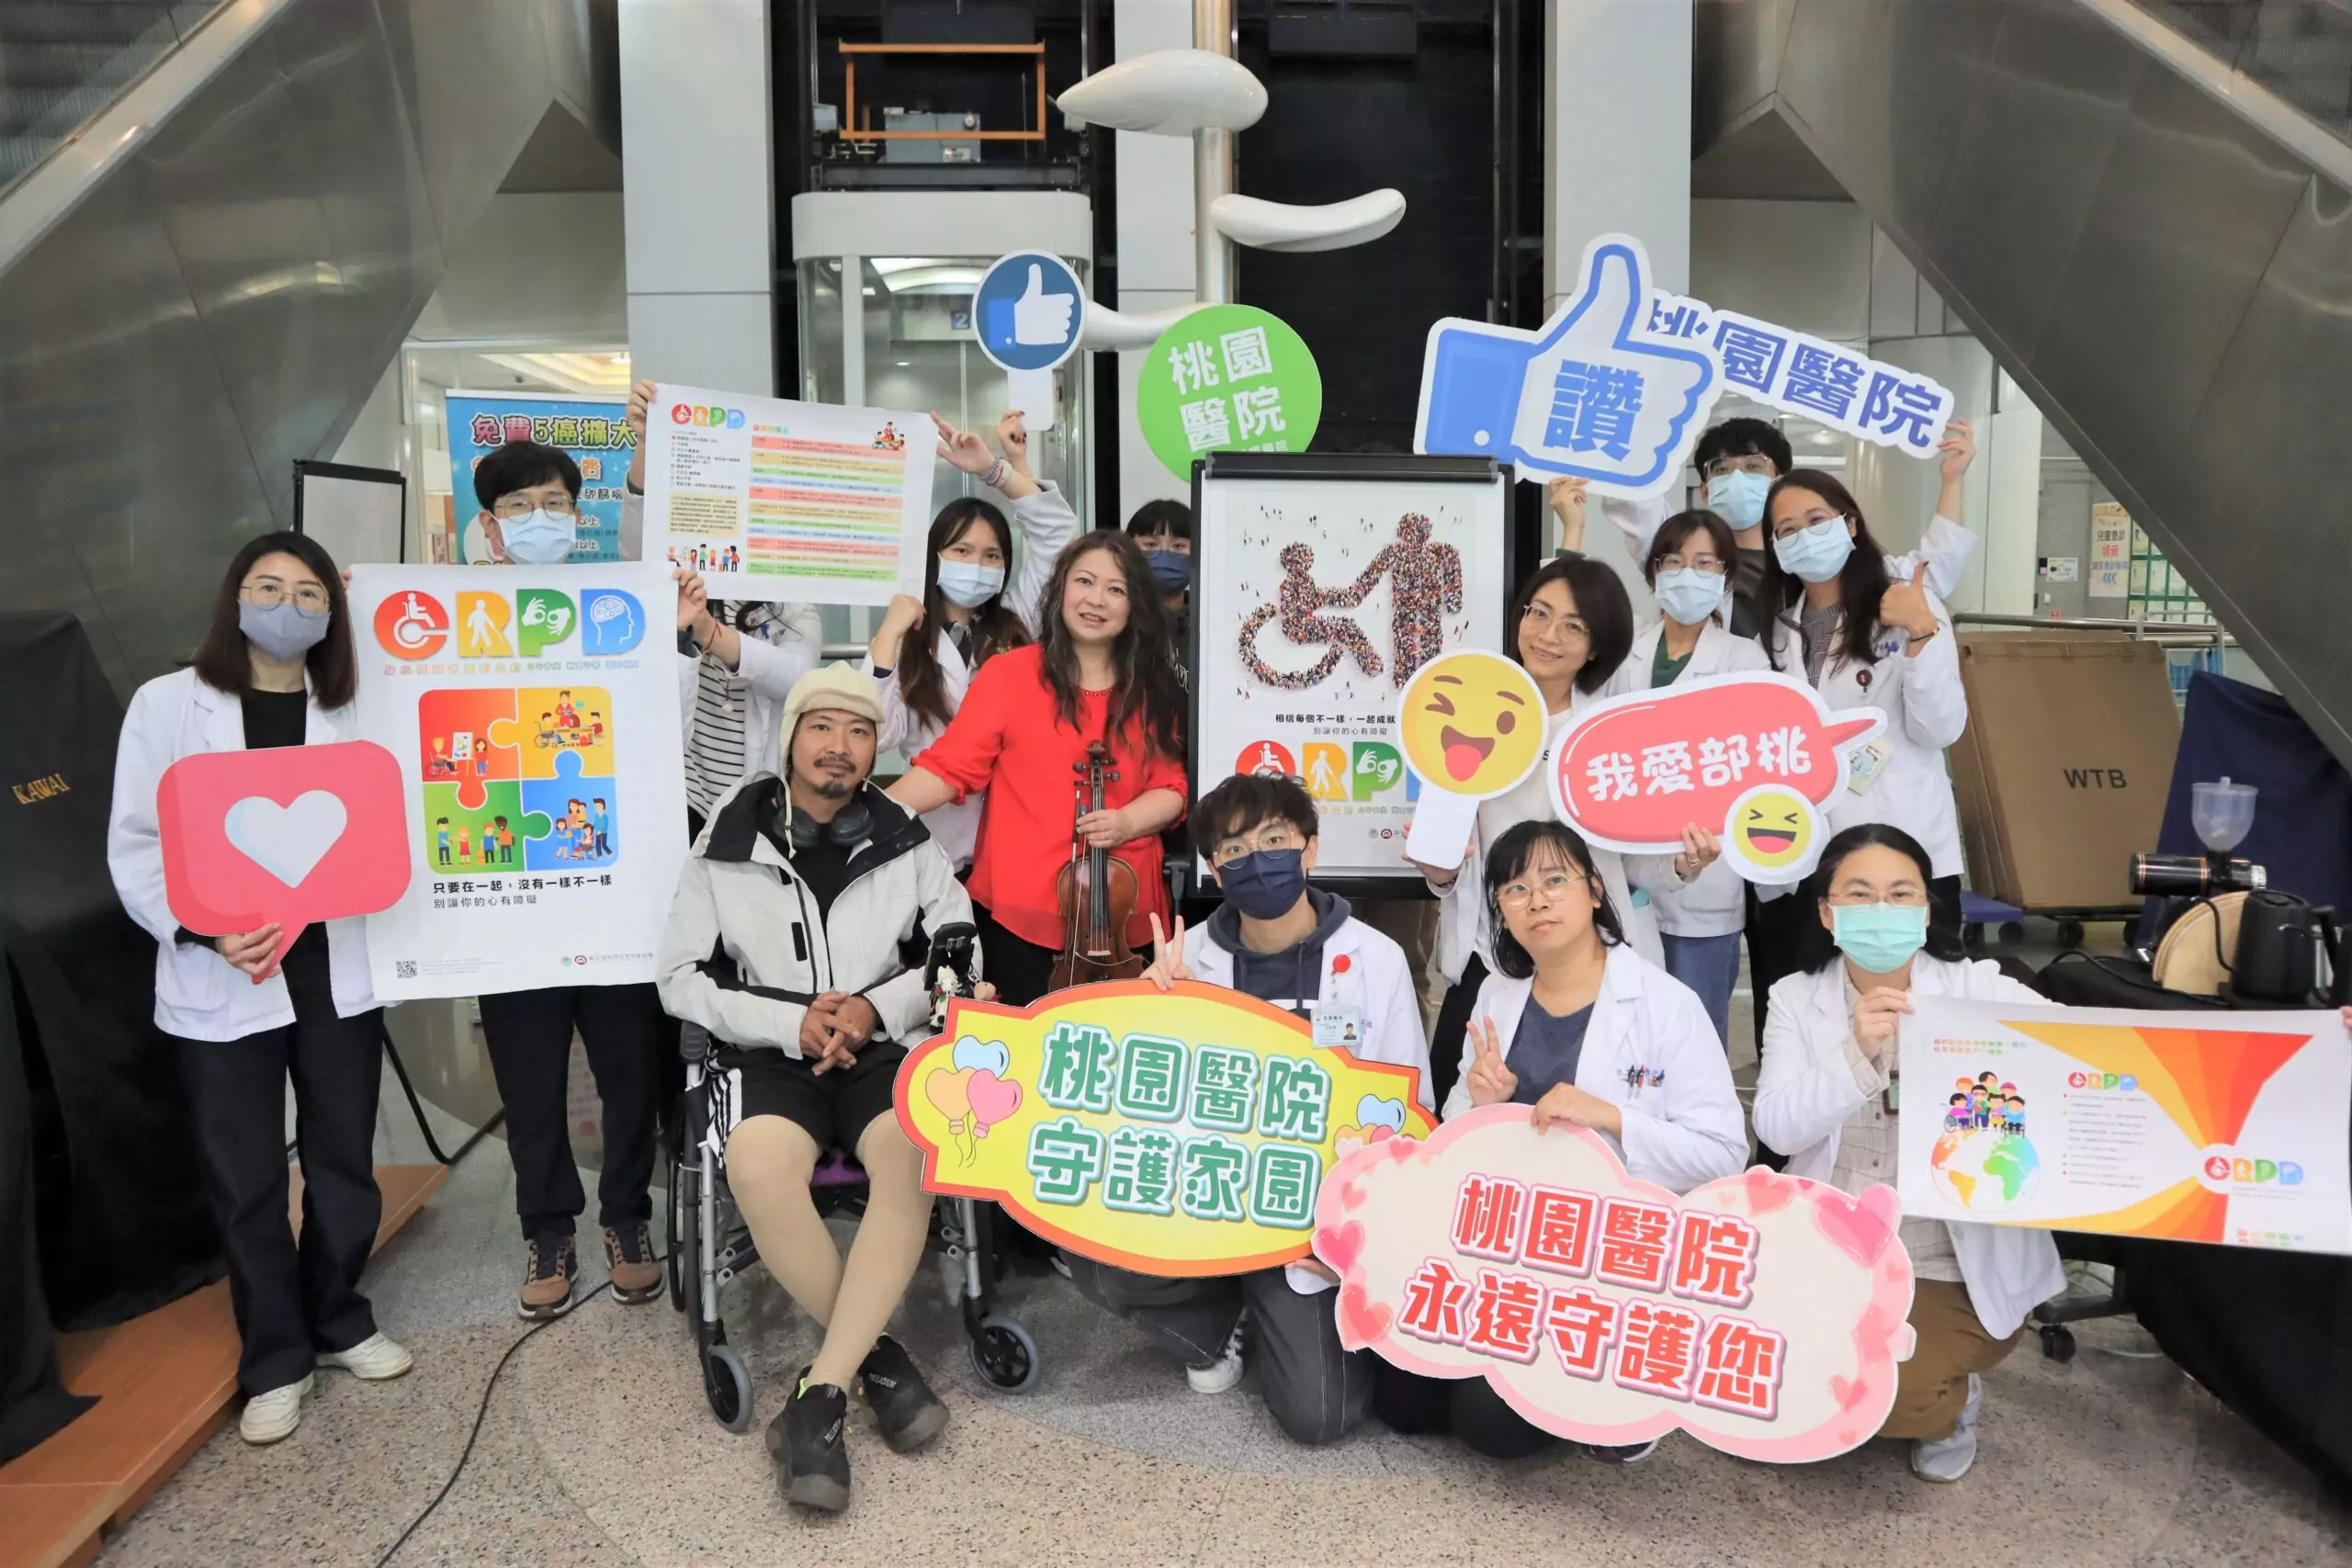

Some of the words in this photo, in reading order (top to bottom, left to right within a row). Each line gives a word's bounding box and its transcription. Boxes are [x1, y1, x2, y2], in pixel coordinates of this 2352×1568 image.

[956, 312, 968, 329] 2
[1168, 326, 1273, 395] 桃園
[672, 404, 745, 429] CRPD
[1180, 386, 1286, 452] 醫院
[1544, 359, 1645, 461] 讚
[374, 588, 646, 660] CRPD
[12, 773, 70, 804] KAWAI
[1585, 724, 1812, 803] 我愛部桃
[2064, 769, 2128, 790] WTB
[434, 874, 612, 894] 只要在一起，沒有一樣不一樣
[434, 895, 537, 908] 別讓你的心有障礙
[1043, 1024, 1328, 1139] 桃園醫院
[1031, 1121, 1318, 1225] 守護家園
[2204, 1156, 2303, 1186] CRPD
[1455, 1177, 1754, 1298] 桃園醫院
[1402, 1261, 1782, 1413] 永遠守護您
